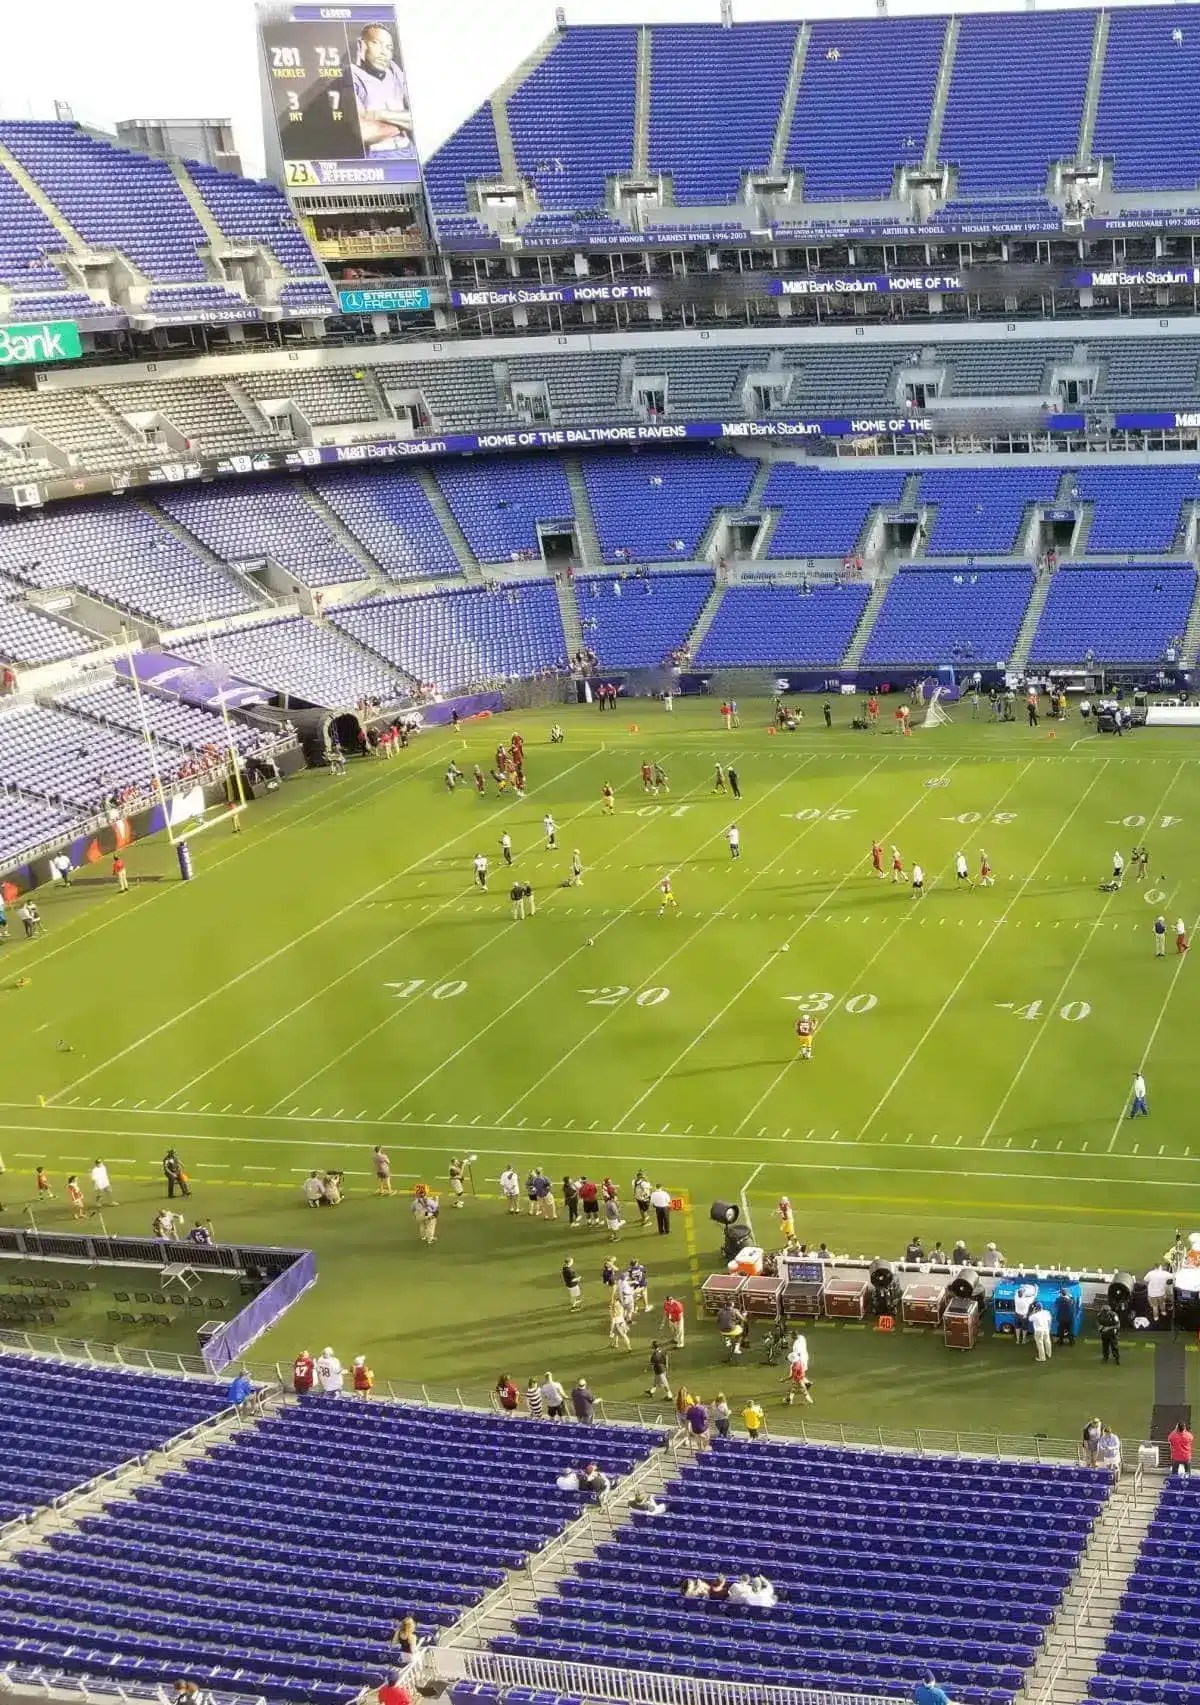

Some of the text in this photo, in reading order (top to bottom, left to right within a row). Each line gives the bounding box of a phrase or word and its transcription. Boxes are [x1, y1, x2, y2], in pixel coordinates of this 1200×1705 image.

[272, 68, 305, 78] TACKLES
[318, 68, 343, 78] SACKS
[286, 91, 300, 110] 3
[328, 91, 340, 109] 7
[332, 111, 343, 120] FF
[290, 164, 308, 182] 23
[889, 278, 960, 289] HOME OF TH
[1120, 272, 1145, 285] Bank
[1145, 271, 1187, 284] Stadium
[809, 280, 835, 292] Bank
[835, 279, 877, 292] Stadium
[363, 290, 422, 300] STRATEGIC
[490, 290, 517, 304] Bank
[518, 290, 563, 303] Stadium
[574, 288, 609, 300] HOME
[612, 287, 628, 298] OF
[365, 299, 422, 309] FACTORY
[750, 422, 777, 435] Bank
[777, 422, 821, 434] Stadium
[852, 419, 932, 432] HOME OF THE
[478, 426, 686, 447] HOME OF THE BALTIMORE RAVENS
[368, 444, 398, 458] Bank
[398, 440, 446, 455] Stadium
[389, 978, 468, 1000] 10
[586, 984, 672, 1006] 20
[797, 992, 878, 1014] 30
[1012, 1000, 1092, 1022] 40
[880, 1316, 891, 1328] 40
